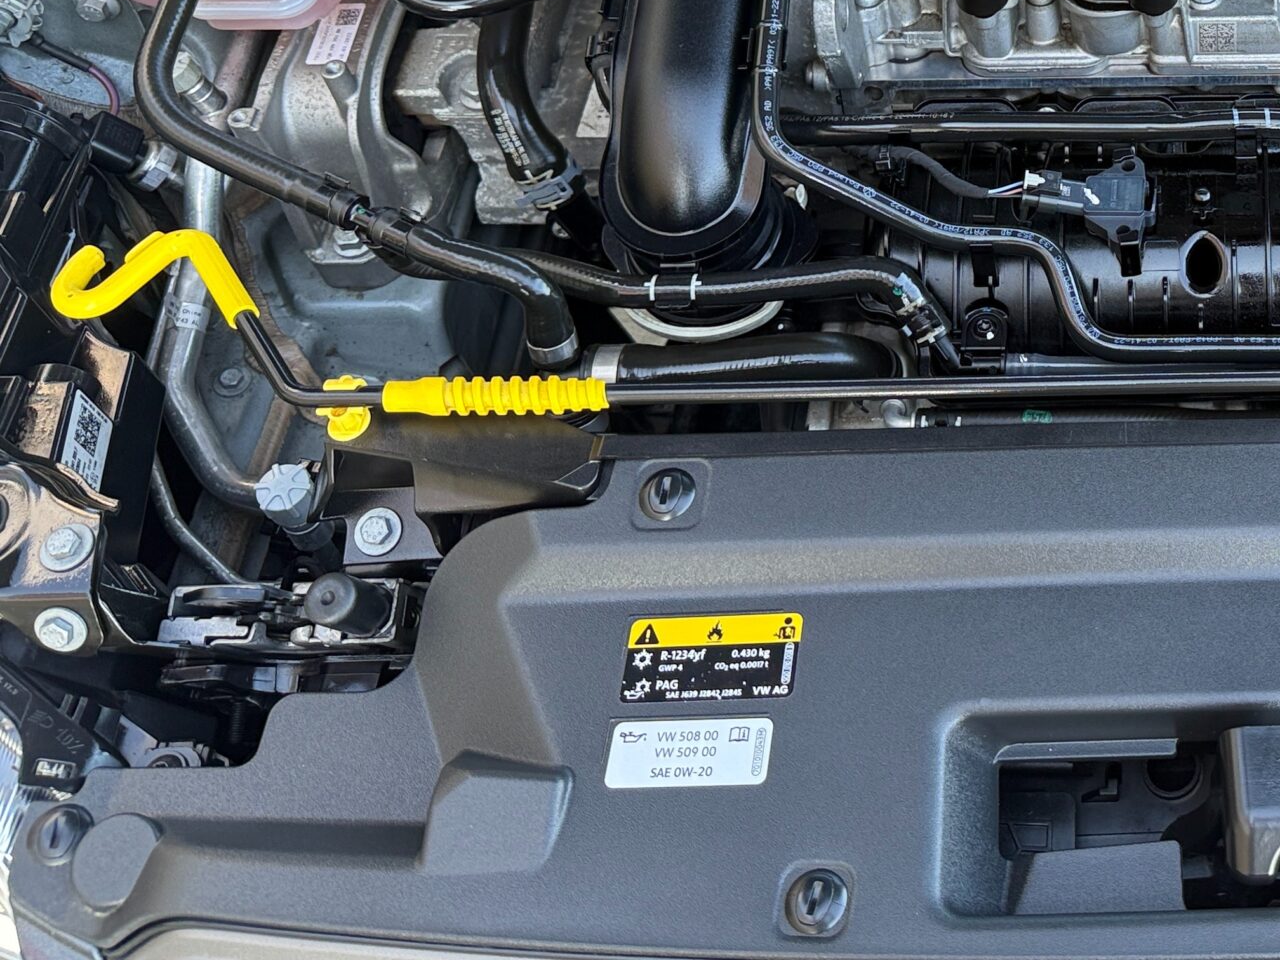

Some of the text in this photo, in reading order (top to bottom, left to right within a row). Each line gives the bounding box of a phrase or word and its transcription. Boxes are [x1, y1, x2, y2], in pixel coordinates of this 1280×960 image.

[764, 115, 775, 132] 352
[770, 134, 786, 149] 133
[1016, 230, 1036, 242] 352
[1038, 237, 1055, 253] 133
[660, 648, 707, 663] R-1234yf
[731, 647, 771, 660] 0.430 kg
[729, 662, 740, 671] eq
[655, 679, 679, 691] PAG
[752, 684, 789, 696] VW AG
[665, 690, 680, 699] SAE
[657, 730, 719, 742] VW 508 00
[654, 746, 717, 758] VW 509 00
[649, 766, 713, 778] SAE 0W-20
